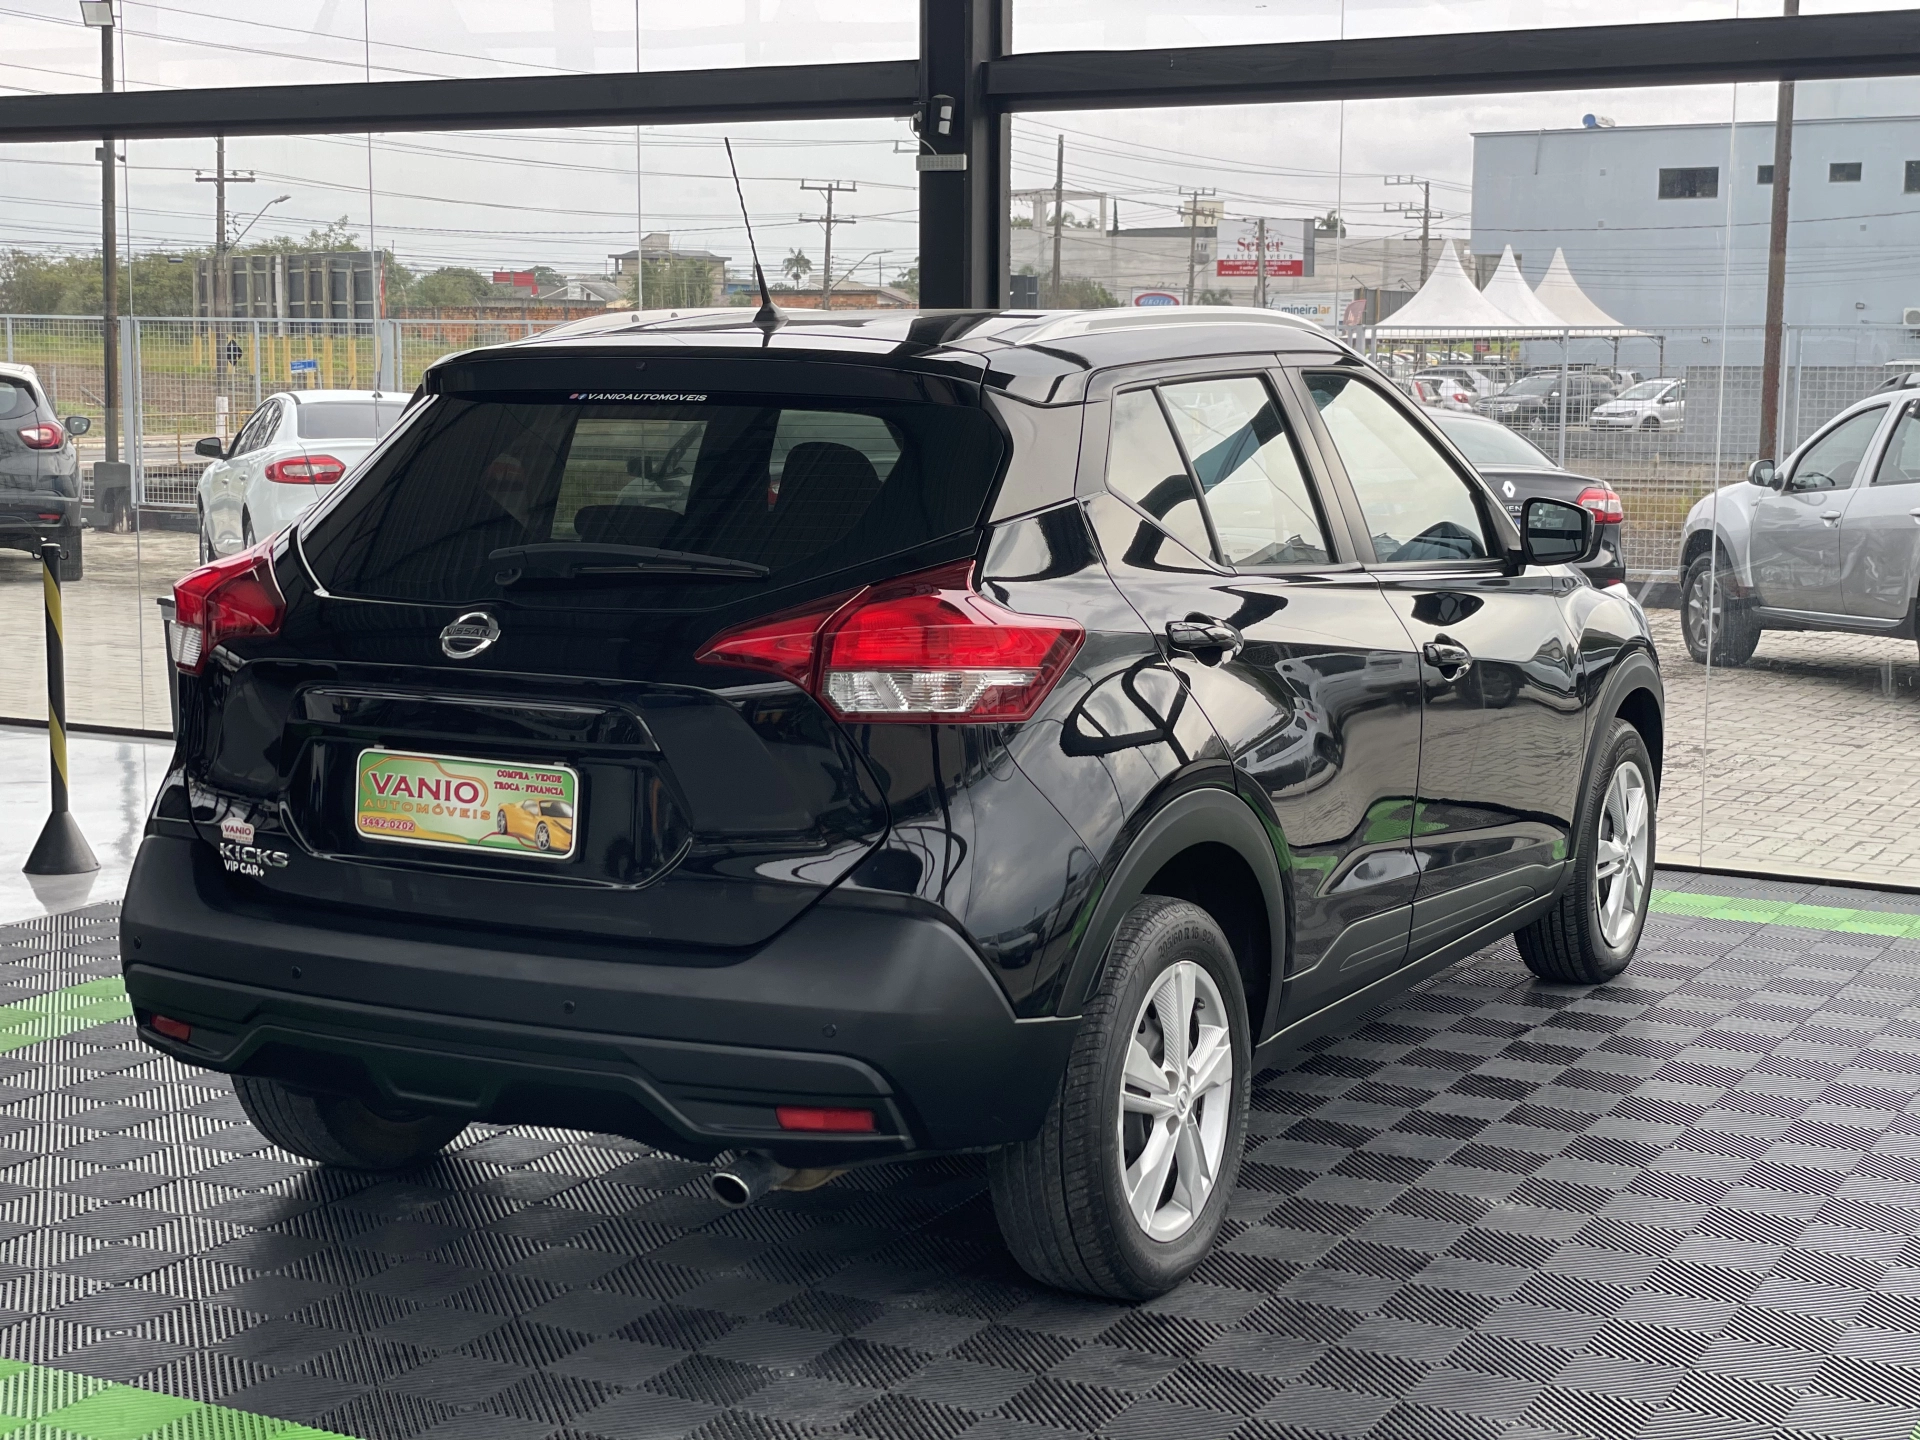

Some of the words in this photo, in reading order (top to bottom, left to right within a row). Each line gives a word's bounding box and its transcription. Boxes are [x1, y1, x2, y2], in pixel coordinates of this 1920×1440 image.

[1237, 235, 1284, 253] Seier
[1281, 304, 1331, 315] mineiralar
[588, 393, 708, 401] VANIOAUTOMOVEIS
[447, 627, 491, 637] NISSAN
[497, 769, 530, 781] COMPRA
[535, 773, 562, 784] VENDE
[370, 772, 479, 804] VANIO
[494, 781, 520, 792] TROCA
[525, 785, 564, 796] FINANCIA
[224, 825, 251, 835] VANIO
[361, 815, 415, 832] 3442-0202
[219, 842, 288, 868] KICKS
[223, 859, 239, 872] VIP
